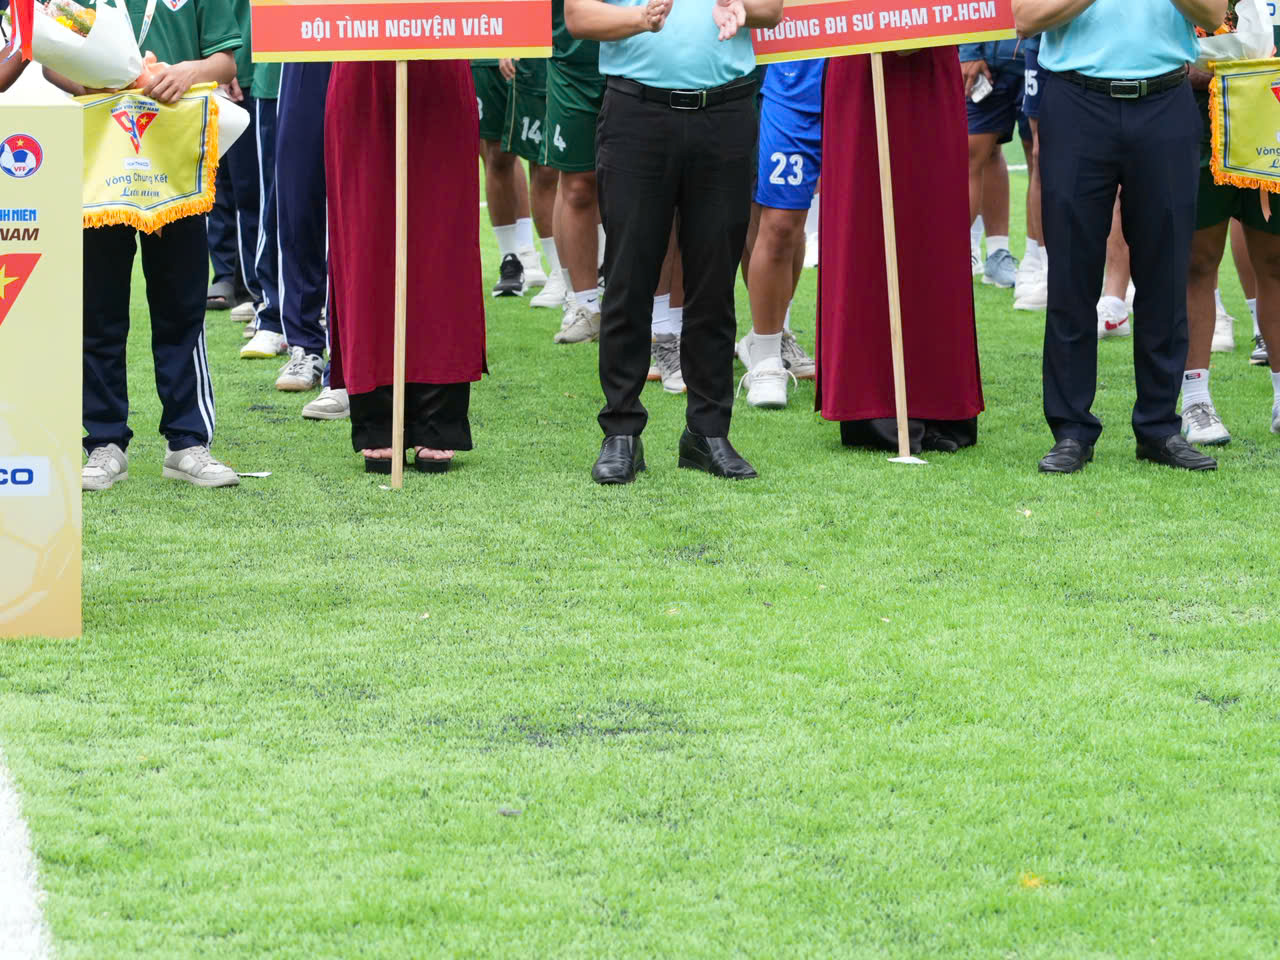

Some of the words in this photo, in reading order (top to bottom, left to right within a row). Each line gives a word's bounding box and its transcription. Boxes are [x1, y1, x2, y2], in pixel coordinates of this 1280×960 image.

[301, 17, 331, 42] ĐỘI
[336, 16, 379, 38] TÌNH
[385, 15, 456, 39] NGUYỆN
[461, 14, 503, 36] VIÊN
[825, 16, 847, 34] ĐH
[852, 11, 874, 31] SƯ
[879, 8, 928, 32] PHẠM
[932, 0, 996, 24] TP.HCM
[521, 116, 543, 144] 14
[553, 123, 566, 152] 4
[133, 172, 153, 184] Chung
[154, 172, 168, 183] Kết
[769, 151, 803, 186] 23
